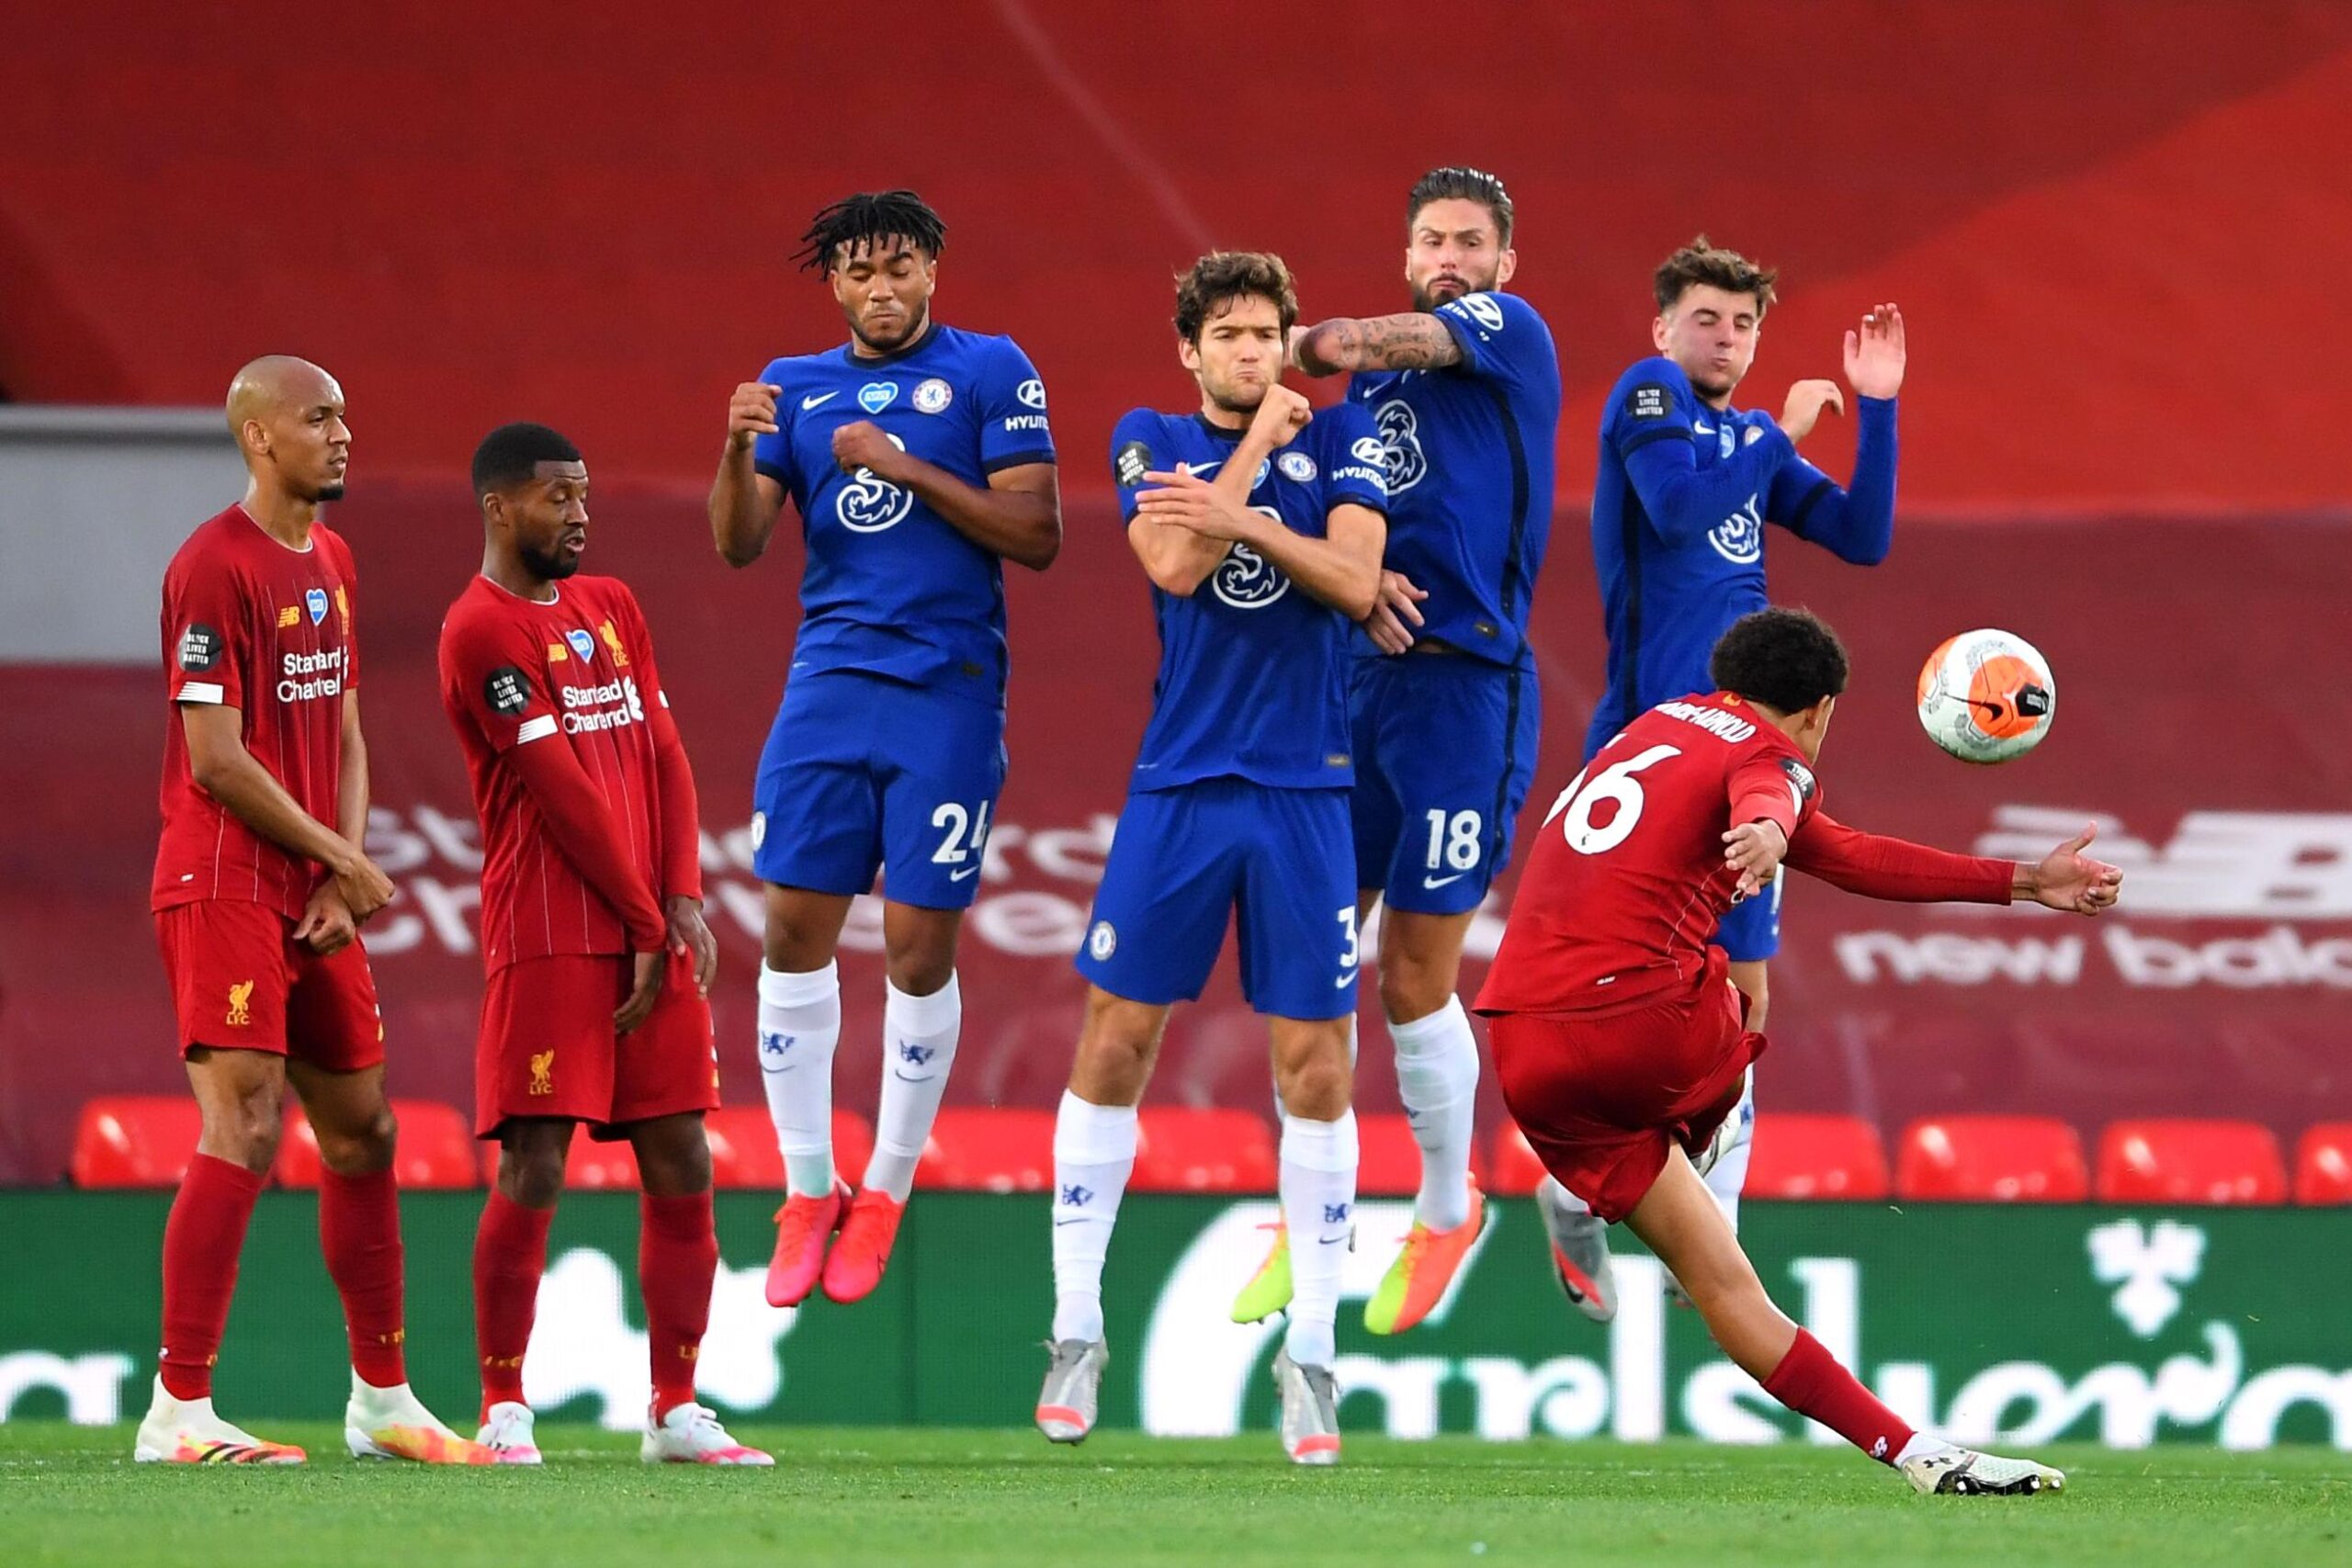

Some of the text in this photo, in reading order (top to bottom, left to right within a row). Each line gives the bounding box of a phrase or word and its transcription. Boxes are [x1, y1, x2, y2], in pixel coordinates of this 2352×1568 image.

[1005, 415, 1049, 431] HYUN
[1427, 808, 1482, 871] 18
[1338, 905, 1359, 968] 3
[1835, 930, 2085, 984] new
[226, 1015, 251, 1025] LFC
